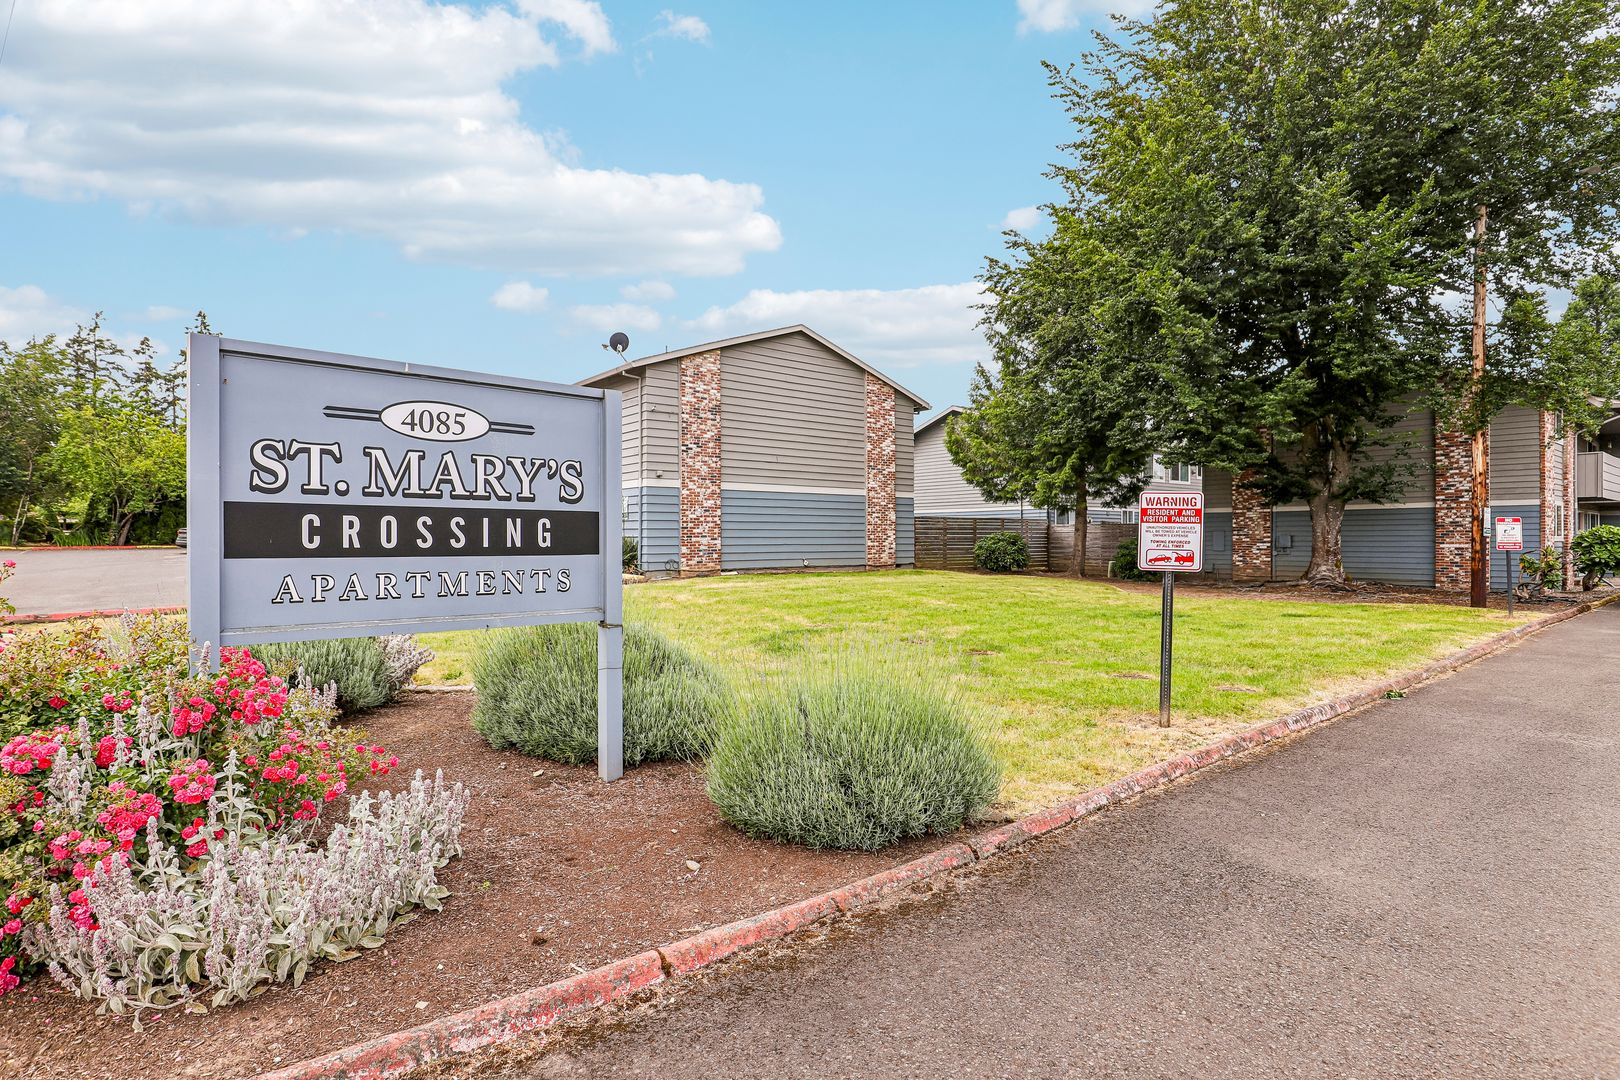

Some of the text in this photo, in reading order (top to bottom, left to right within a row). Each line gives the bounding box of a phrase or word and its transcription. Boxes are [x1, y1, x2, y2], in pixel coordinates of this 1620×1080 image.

[401, 408, 466, 436] 4085
[250, 438, 584, 504] ST. MARY’S
[1146, 497, 1197, 507] WARNING
[301, 514, 552, 549] CROSSING
[272, 569, 572, 604] APARTMENTS
